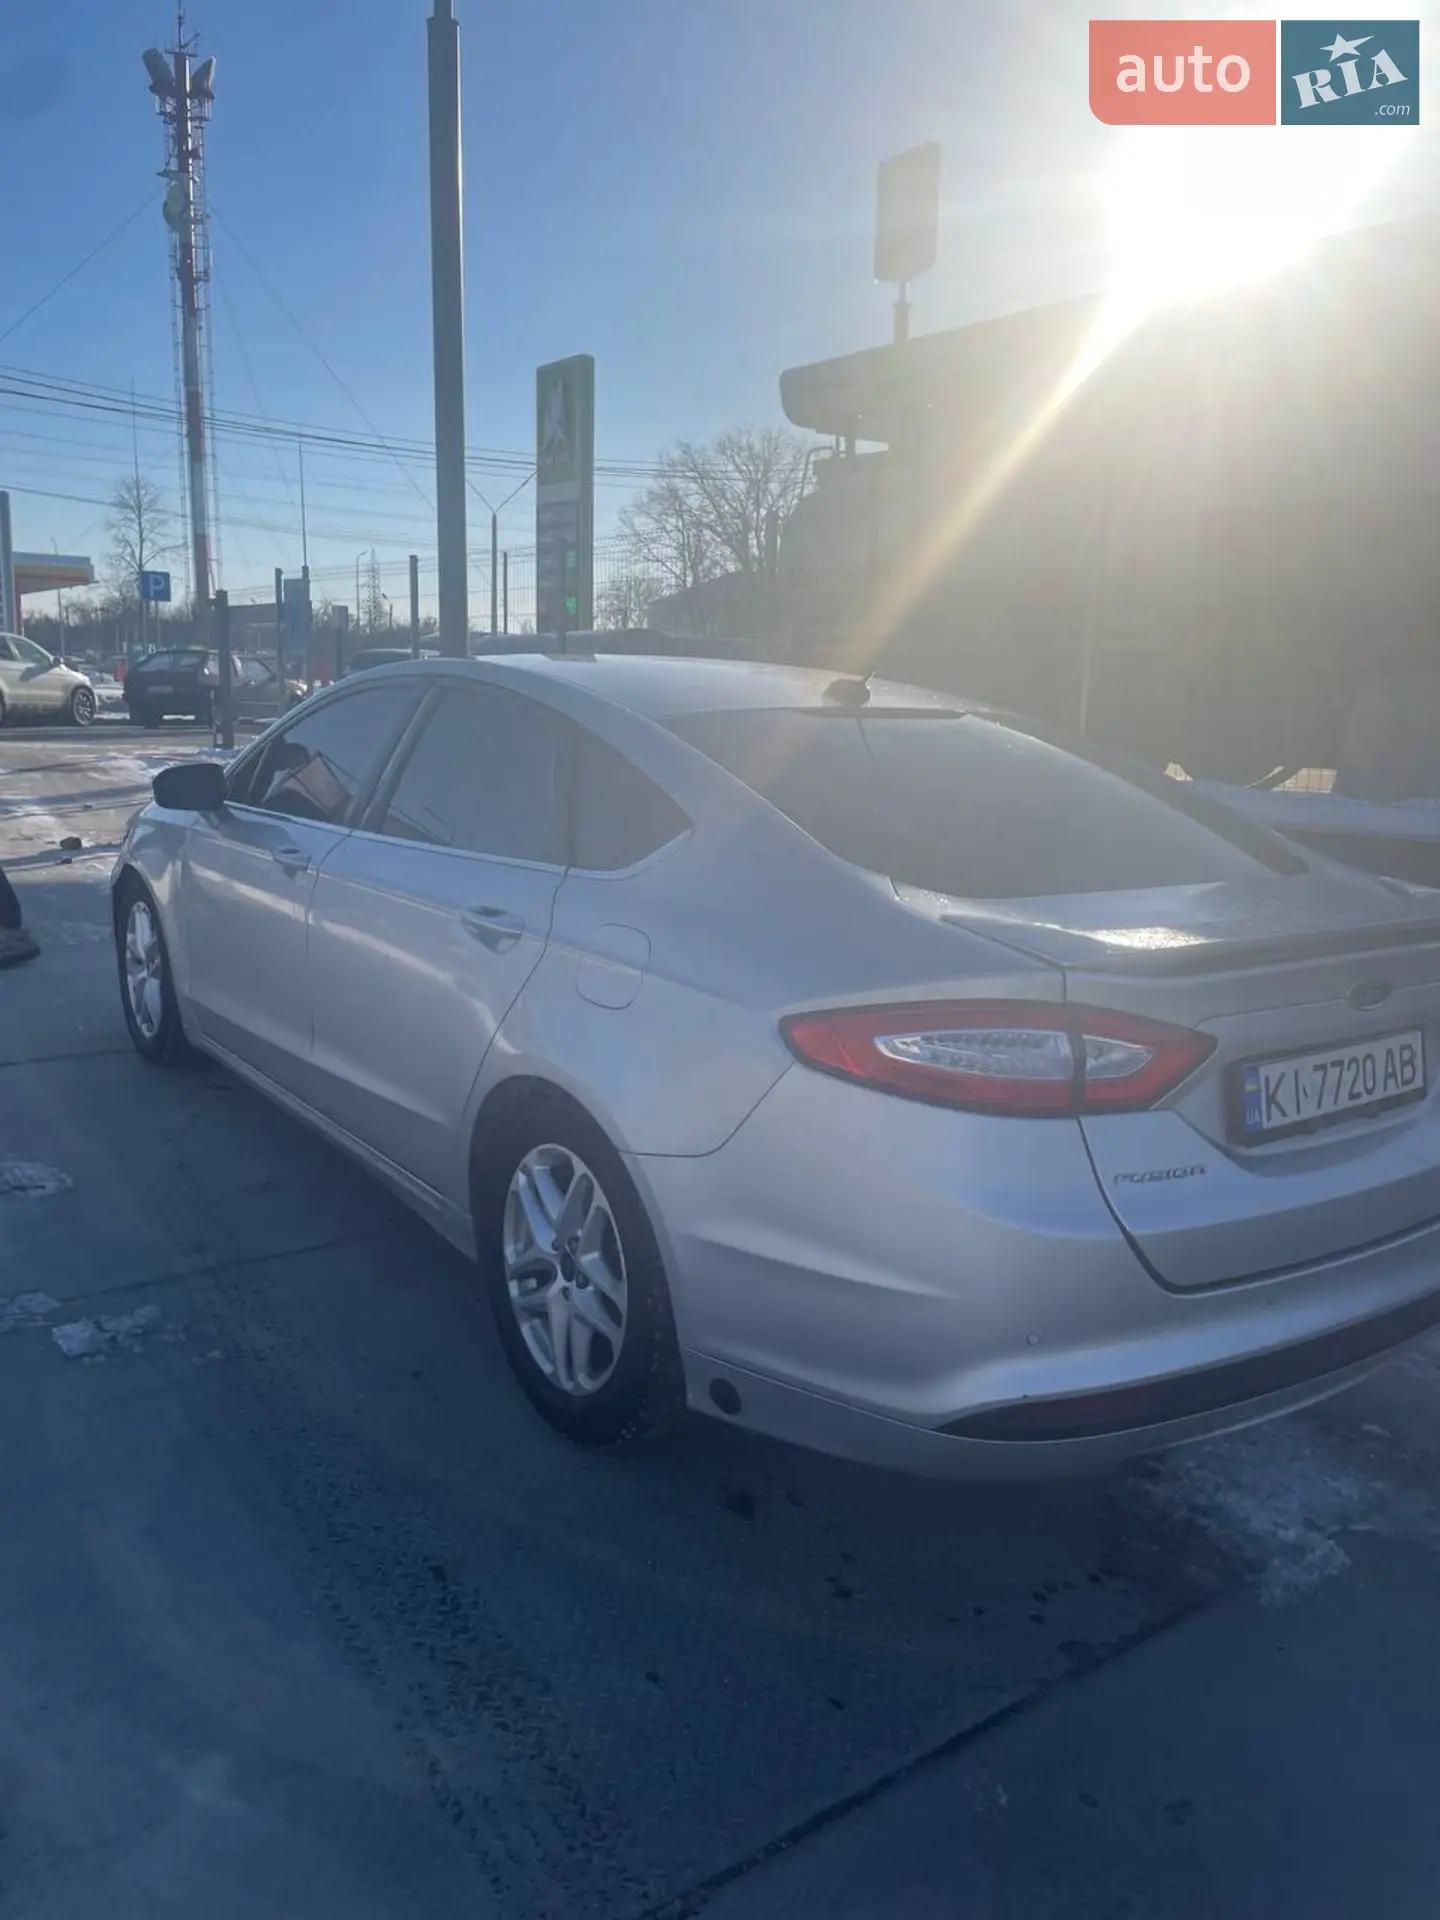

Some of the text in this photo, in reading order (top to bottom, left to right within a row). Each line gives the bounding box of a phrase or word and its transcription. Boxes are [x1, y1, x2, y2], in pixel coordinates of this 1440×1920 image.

[150, 573, 165, 598] P
[1312, 1053, 1377, 1110] 7720
[1383, 1043, 1417, 1093] AB
